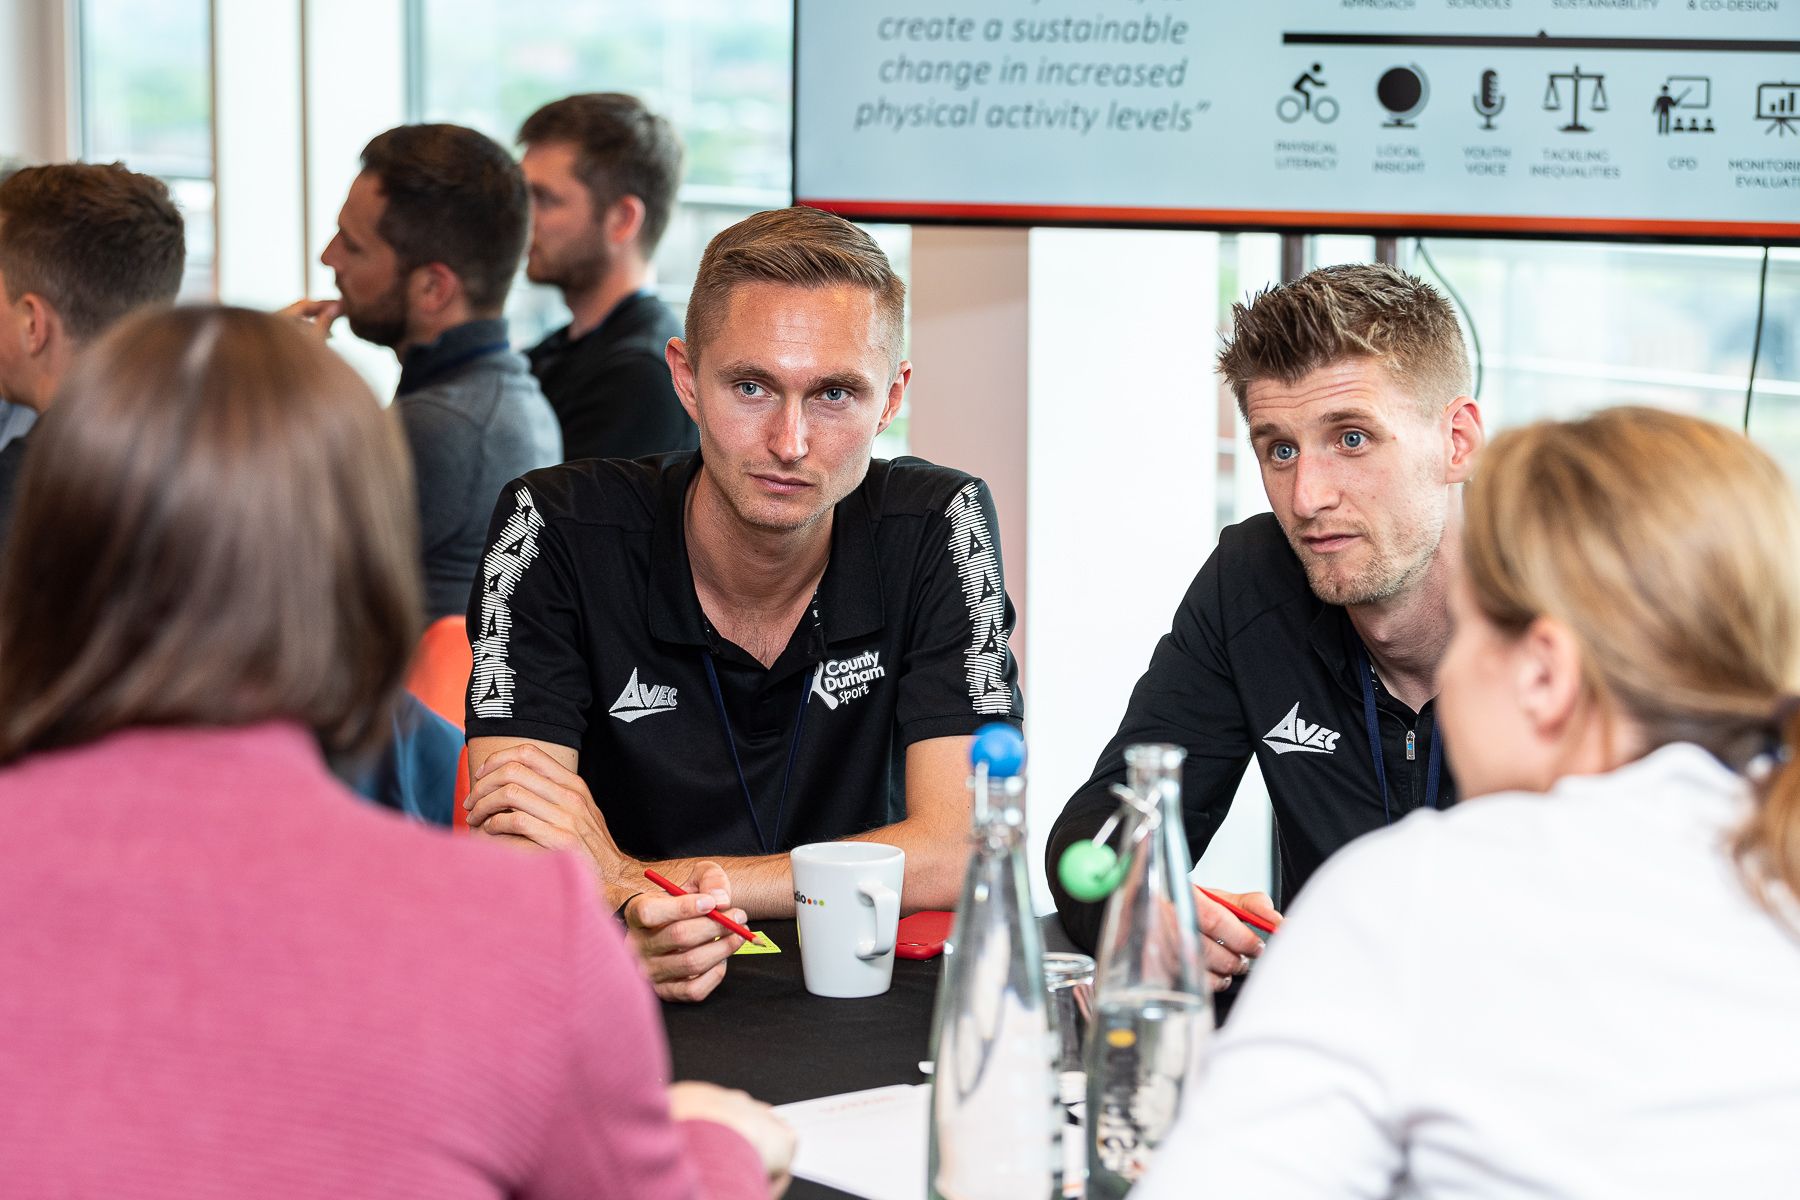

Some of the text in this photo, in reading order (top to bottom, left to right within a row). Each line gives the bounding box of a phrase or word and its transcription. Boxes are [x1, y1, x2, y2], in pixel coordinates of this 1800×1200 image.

[1552, 0, 1659, 9] SUSTAINABILITY
[1700, 0, 1778, 11] CO-DESIGN
[877, 13, 1189, 44] create a sustainable
[877, 54, 1189, 91] change in increased
[854, 97, 981, 132] physical
[984, 99, 1101, 135] activity
[1668, 157, 1698, 171] CPD
[825, 651, 880, 677] County
[609, 667, 678, 708] AVEC
[824, 665, 885, 692] Durham
[839, 683, 870, 704] sport
[1263, 701, 1341, 751] AVEC
